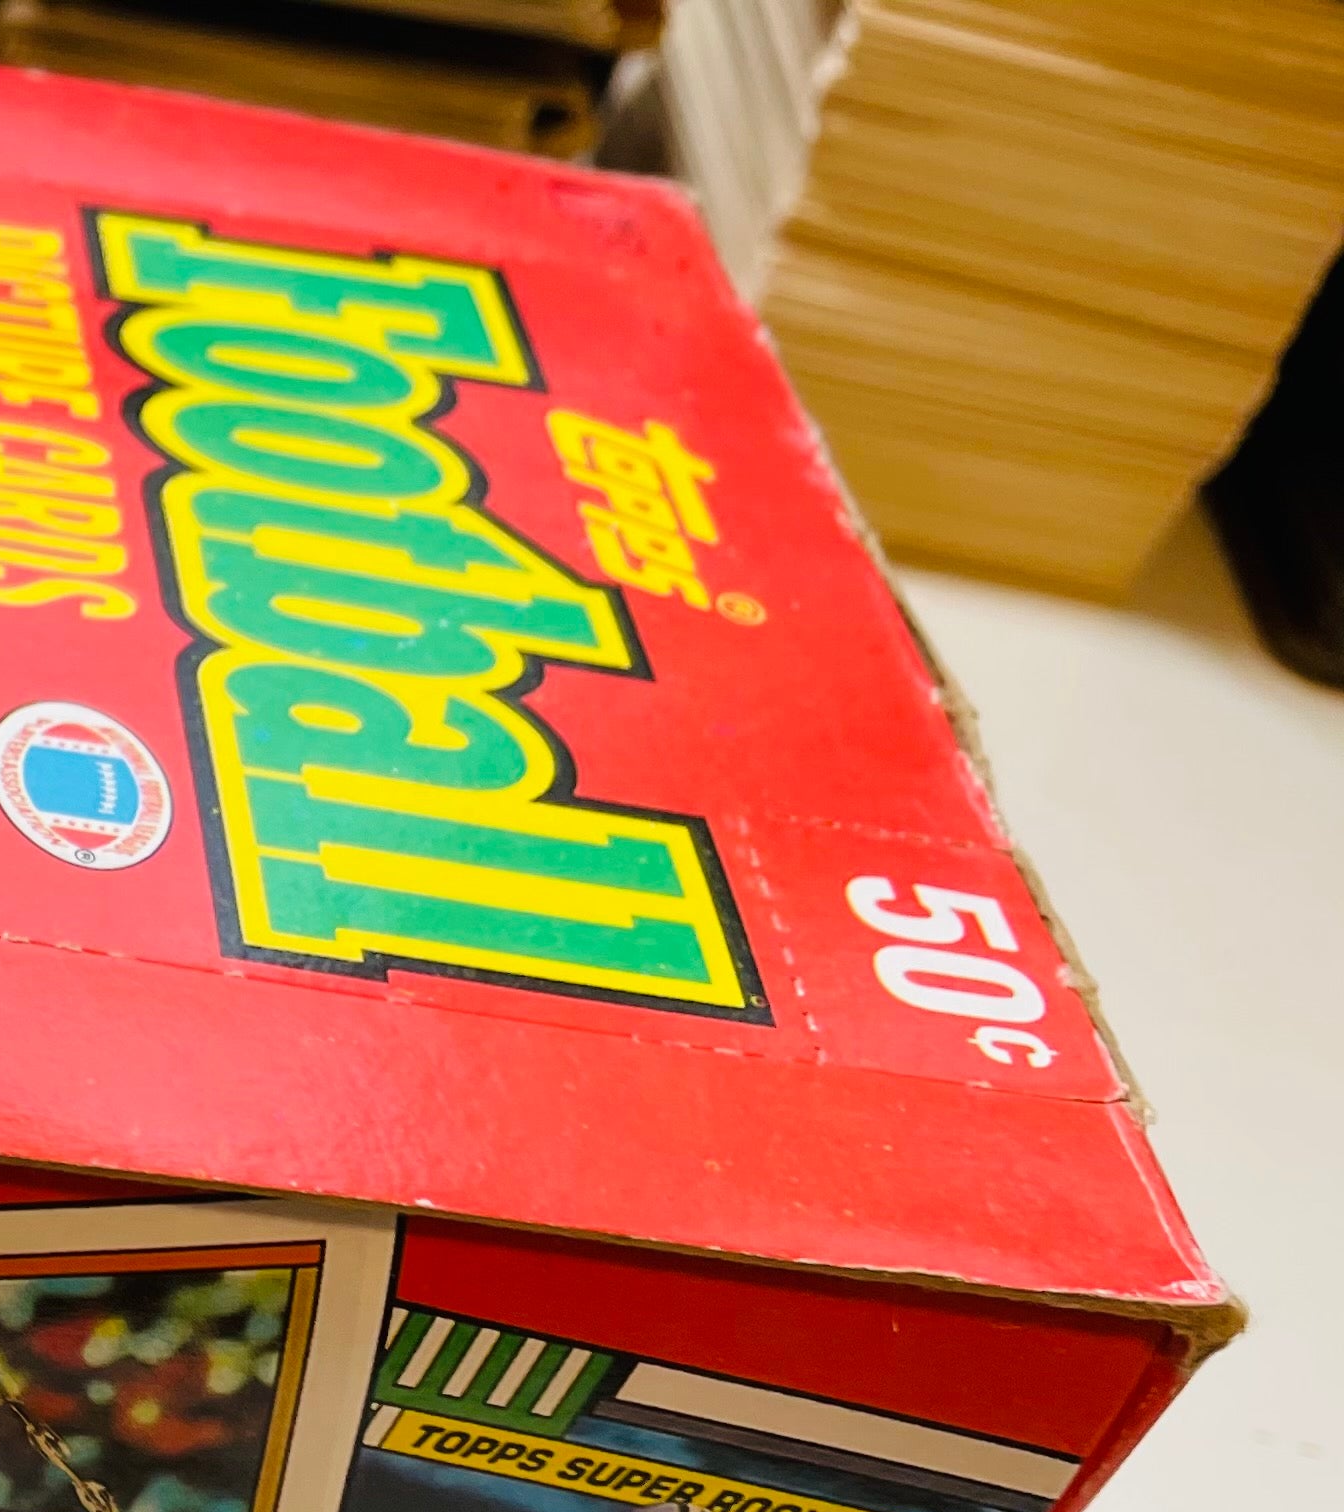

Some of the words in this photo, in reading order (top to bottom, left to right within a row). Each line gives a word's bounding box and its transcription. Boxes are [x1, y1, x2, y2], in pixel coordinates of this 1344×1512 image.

[92, 209, 752, 1015] Football
[411, 1422, 554, 1473] TOPPS
[557, 1457, 704, 1507] SUPER
